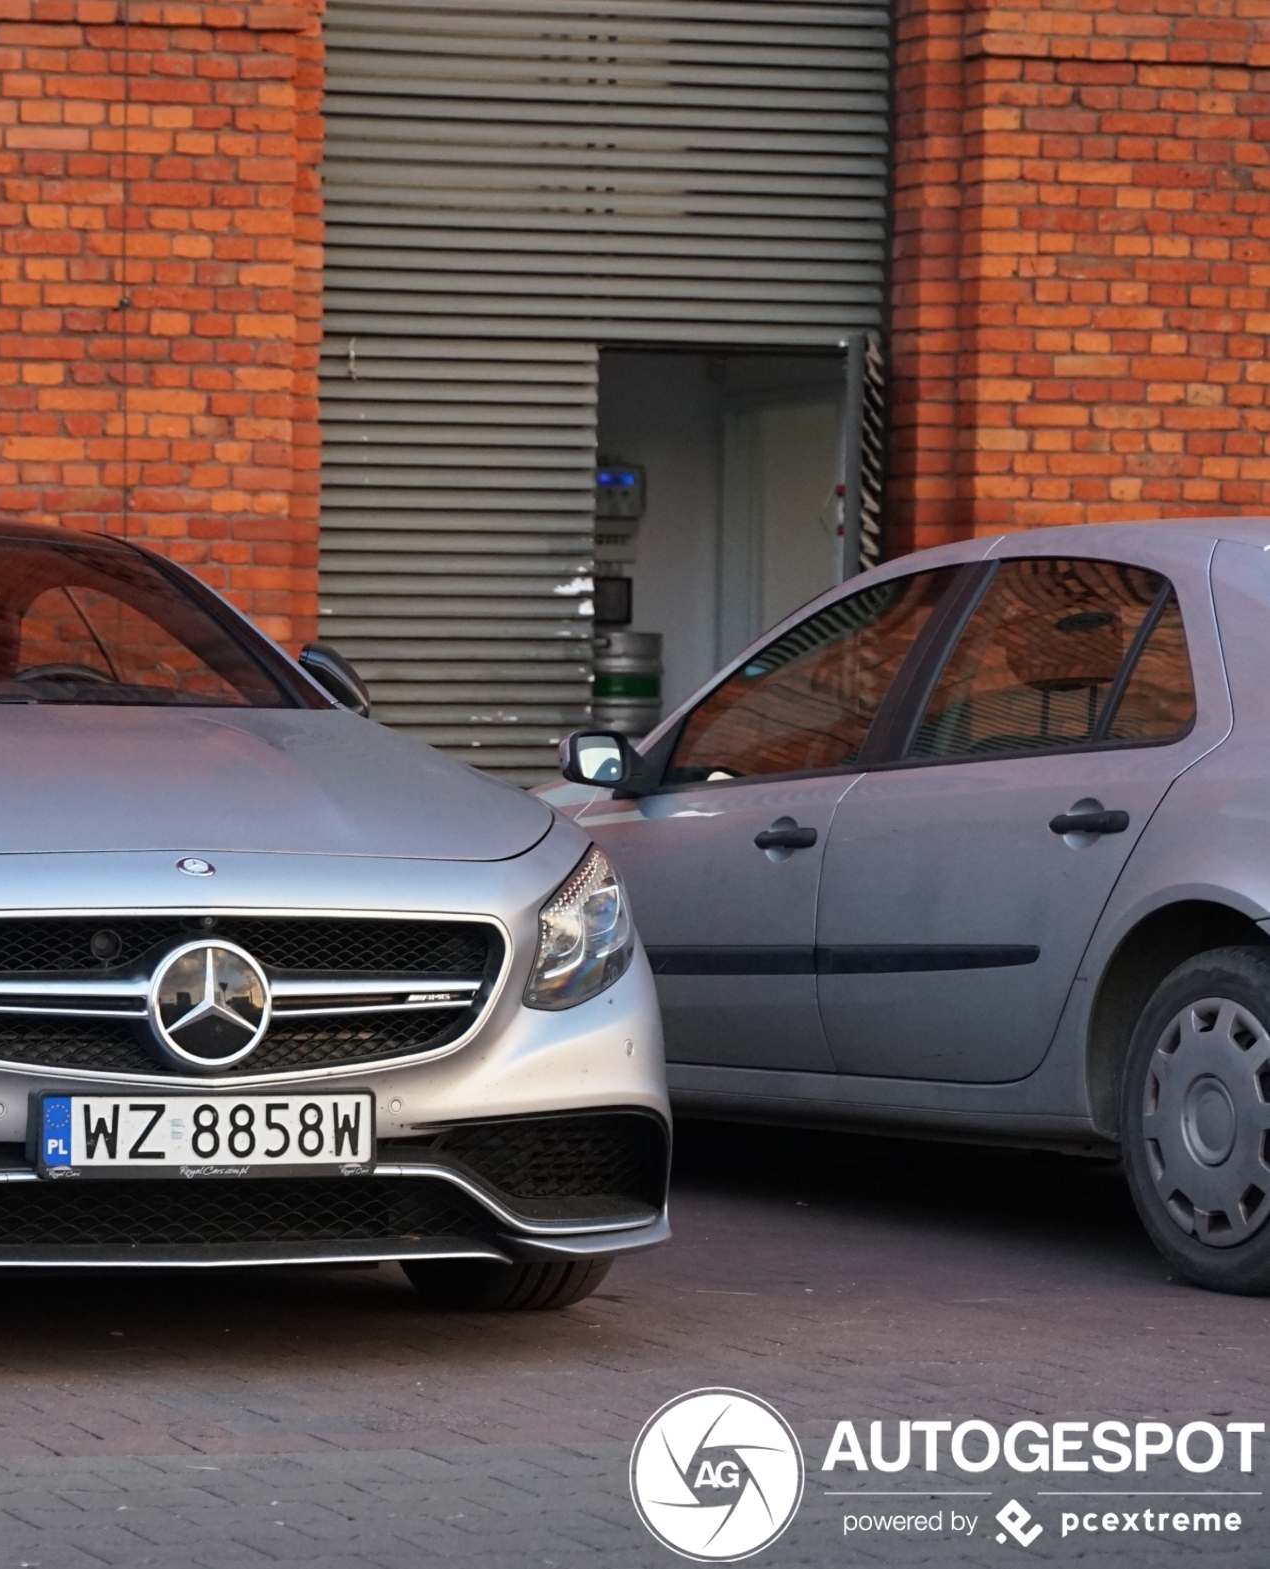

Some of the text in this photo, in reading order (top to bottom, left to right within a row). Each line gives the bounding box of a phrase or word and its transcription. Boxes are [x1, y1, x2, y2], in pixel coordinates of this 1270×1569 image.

[47, 1138, 68, 1155] PL
[83, 1101, 362, 1160] WZ 8858W
